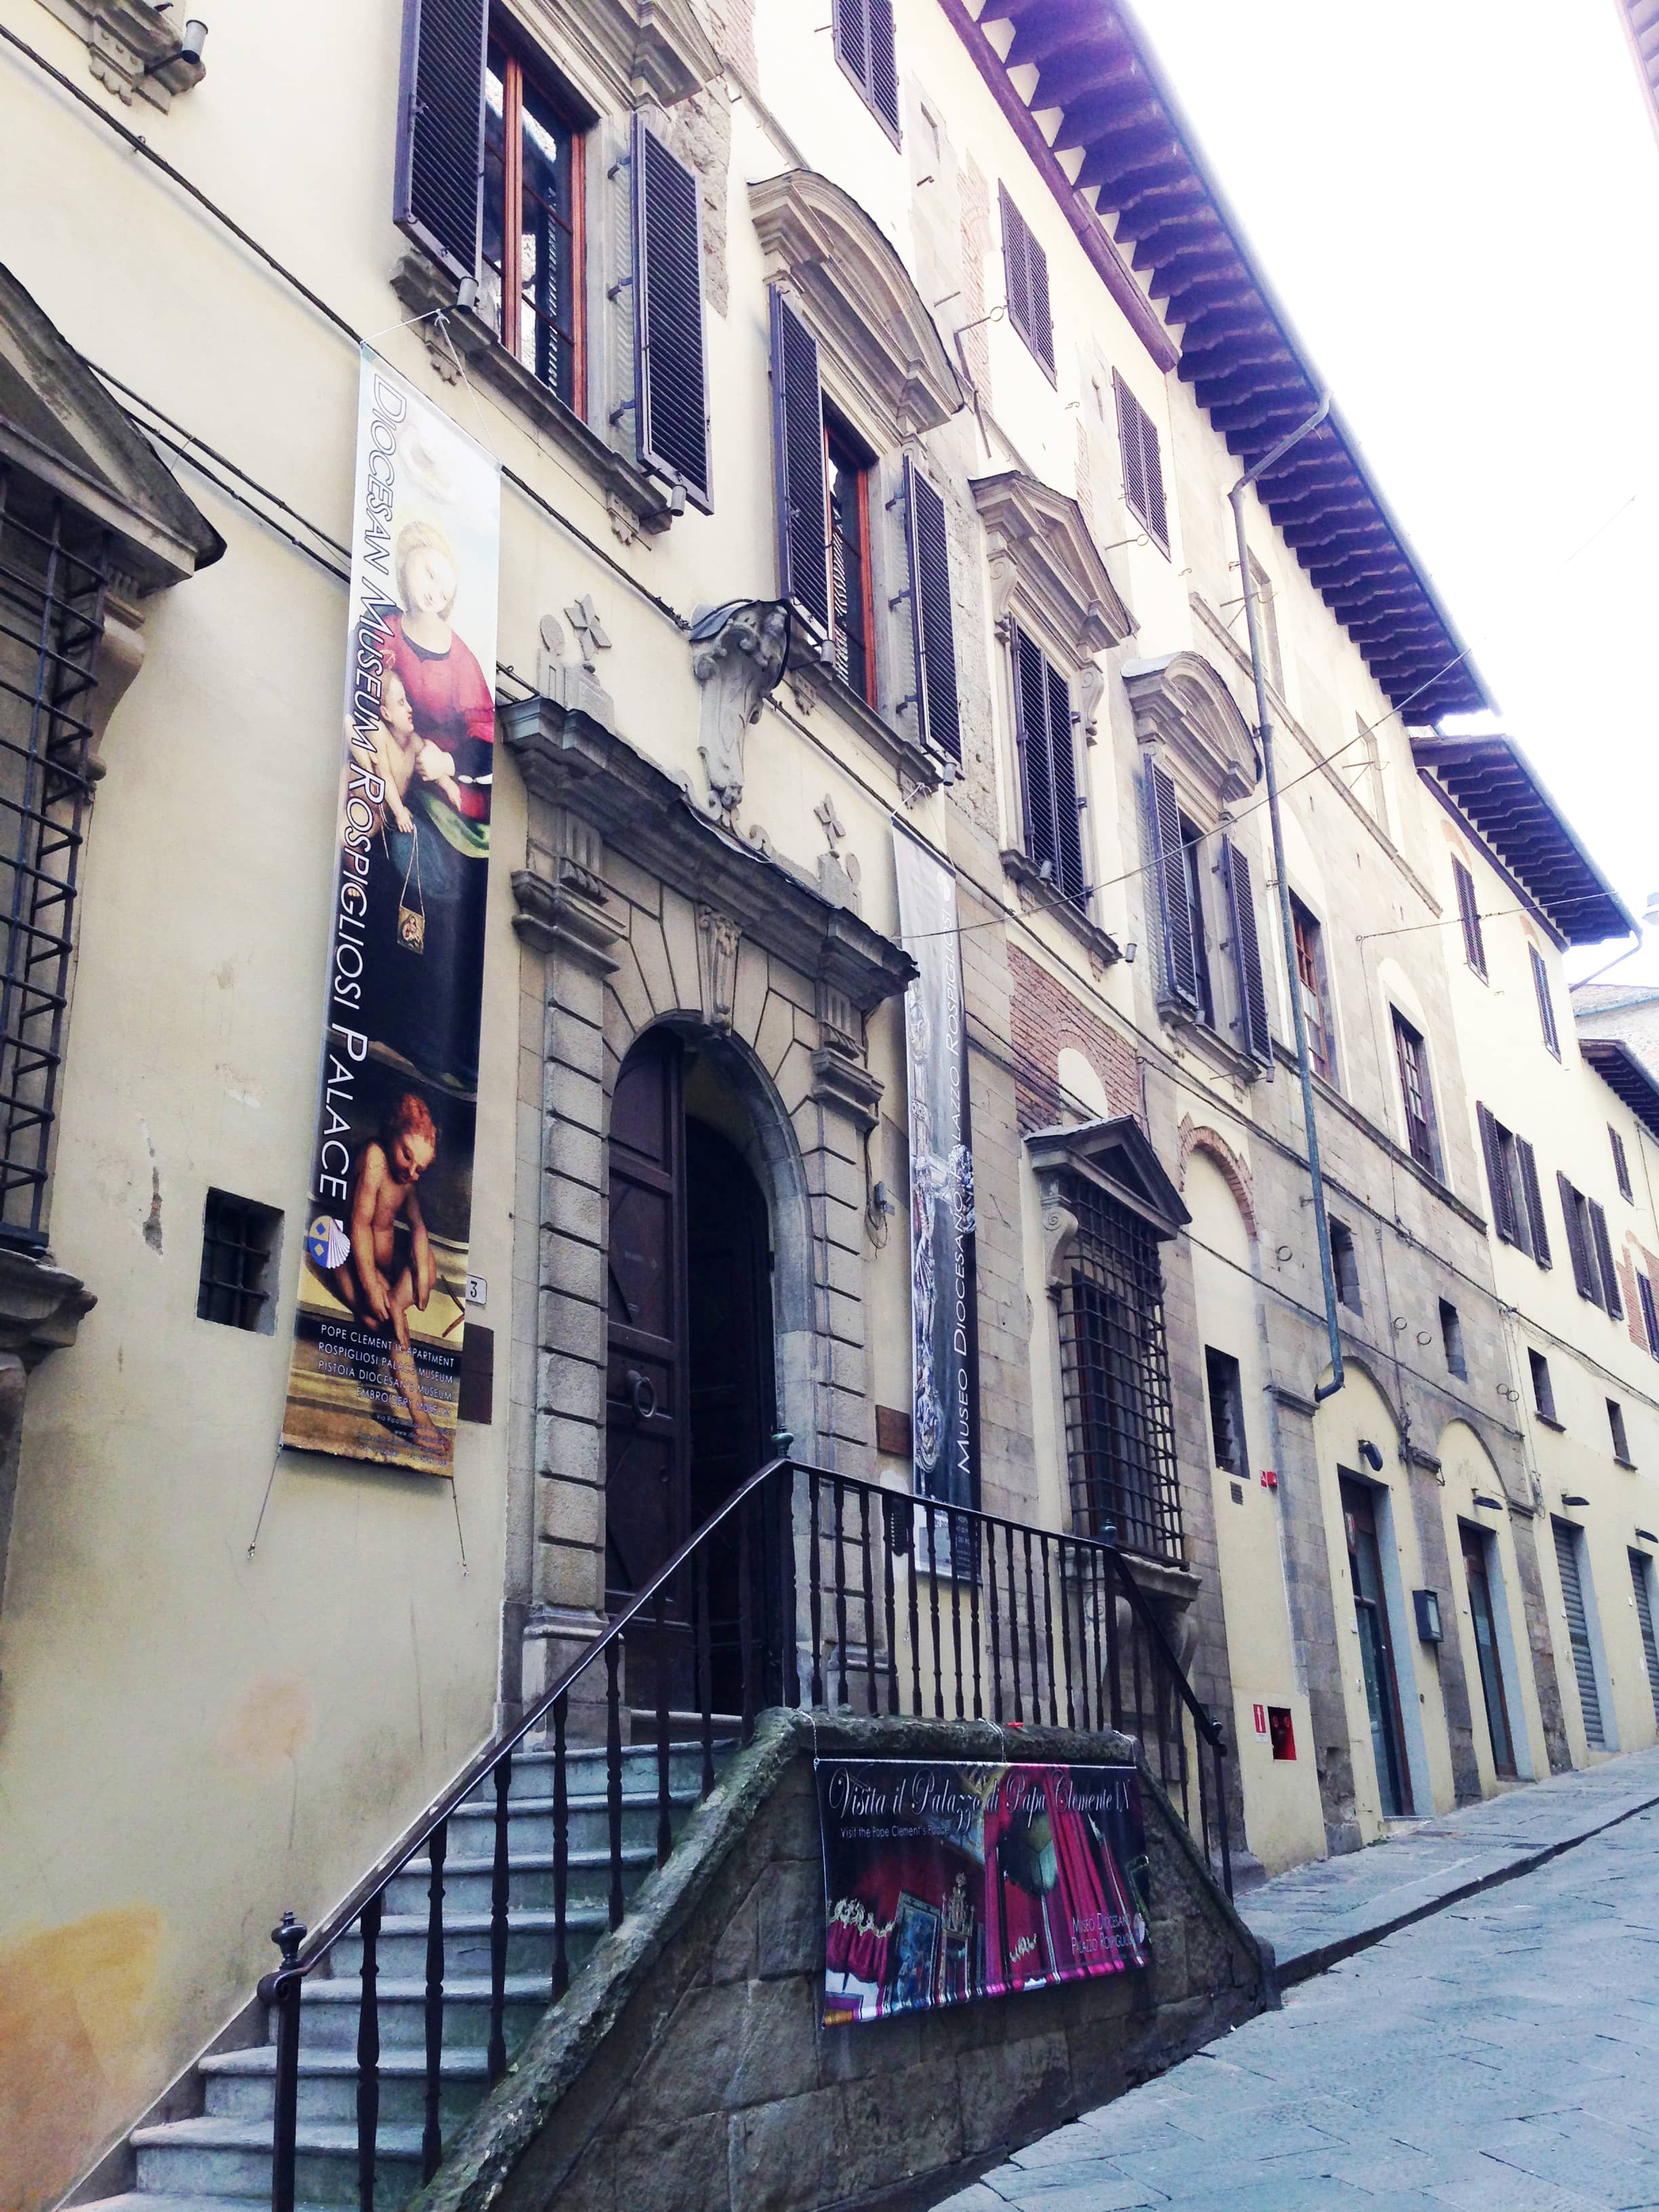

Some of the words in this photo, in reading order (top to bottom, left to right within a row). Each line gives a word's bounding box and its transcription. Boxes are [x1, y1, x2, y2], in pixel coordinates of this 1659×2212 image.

[363, 374, 407, 575] DIOCESAN
[350, 576, 403, 754] MUSEUM
[333, 762, 386, 1010] ROSPIGLIOSI
[942, 909, 959, 1056] ROSPIGLIOSI
[319, 1023, 368, 1201] PALACE
[949, 1065, 962, 1181] PALAZZO
[470, 1280, 477, 1298] 3
[954, 1191, 967, 1357] DIOCESANO
[319, 1342, 378, 1365] ROSPIGLIOSI
[382, 1358, 415, 1374] PALACE
[418, 1368, 453, 1384] MUSEUM
[319, 1361, 355, 1377] PISTOIA
[417, 1385, 452, 1400] MUSEUM
[321, 1324, 347, 1340] POPE
[350, 1332, 392, 1351] CLEMENT
[407, 1348, 455, 1368] APARTMENT
[957, 1368, 971, 1475] MUSEO
[829, 1764, 886, 1819] Visita
[893, 1779, 906, 1814] il
[912, 1767, 980, 1833] Palazzo
[987, 1779, 1000, 1811] di
[1006, 1771, 1046, 1828] Papa
[1051, 1769, 1112, 1812] Clemente
[840, 1826, 856, 1838] Visit
[859, 1826, 870, 1837] the
[872, 1826, 889, 1837] Pope
[892, 1825, 926, 1837] Clement's
